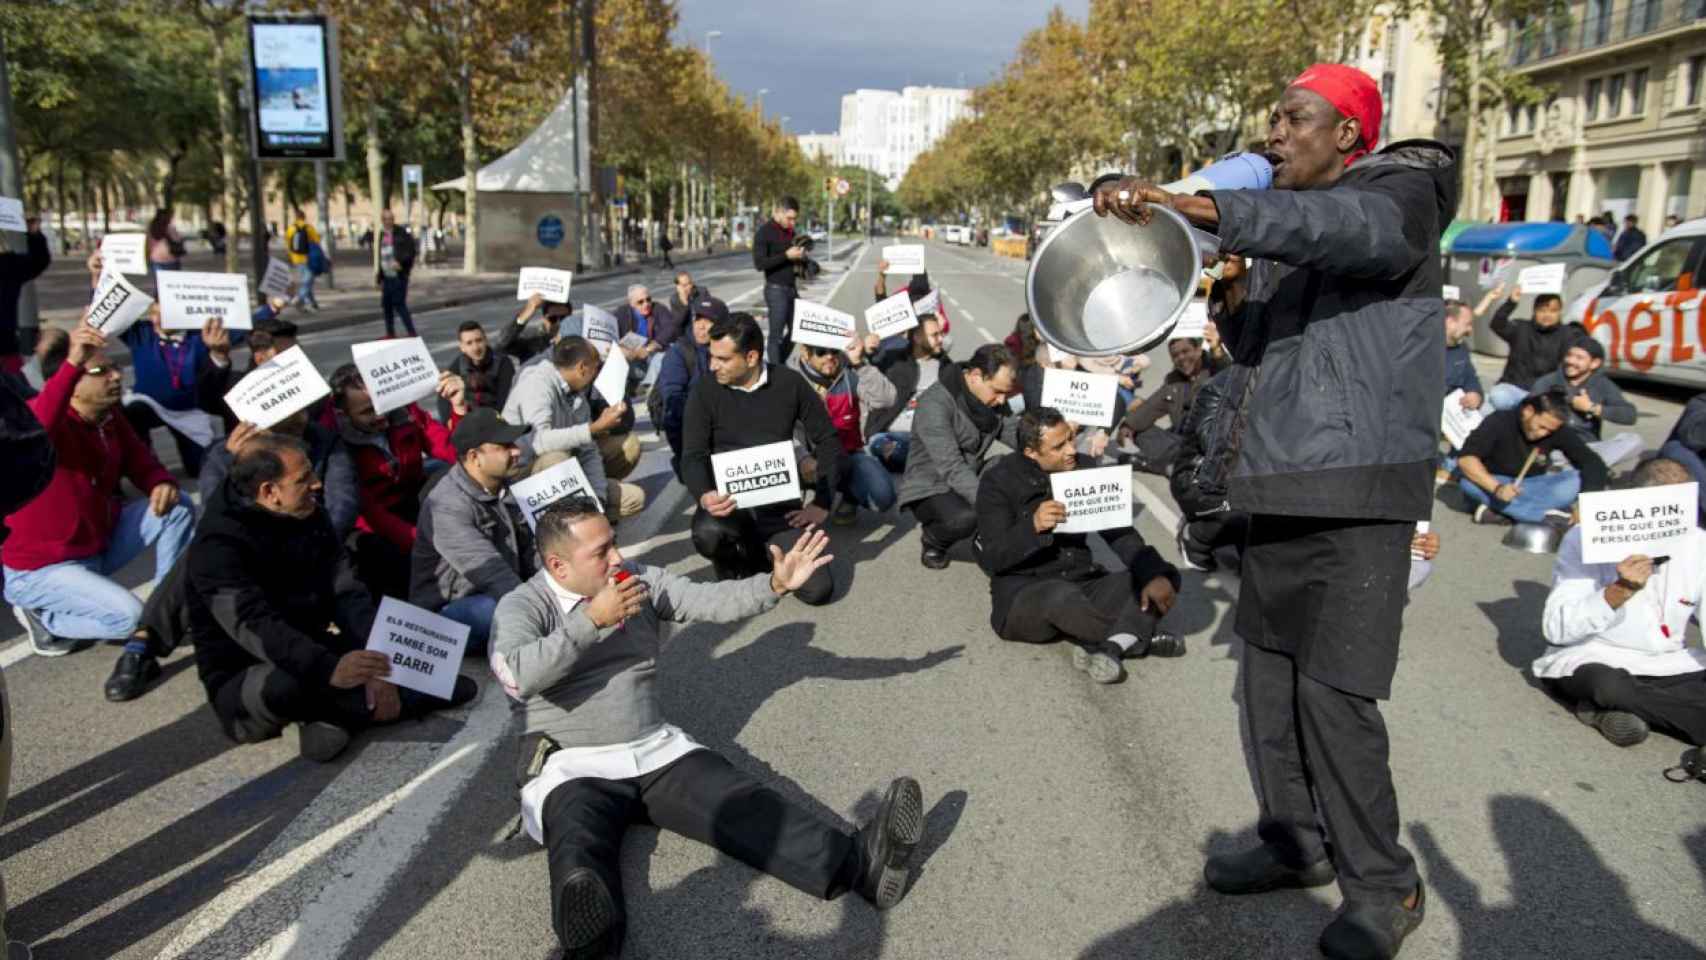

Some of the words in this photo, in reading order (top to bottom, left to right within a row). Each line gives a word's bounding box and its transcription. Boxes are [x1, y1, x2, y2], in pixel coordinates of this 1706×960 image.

[213, 295, 235, 303] SOM
[185, 306, 228, 315] BARRI
[370, 363, 401, 379] GALA
[377, 375, 393, 386] PER
[395, 370, 410, 381] QUE
[411, 364, 426, 376] ENS
[1070, 381, 1089, 391] NO
[260, 386, 302, 412] BARRI
[725, 463, 762, 479] GALA
[764, 456, 787, 470] PIN
[526, 485, 560, 508] GALA
[559, 475, 580, 493] PIN
[728, 472, 788, 493] DIALOGA
[1064, 486, 1097, 499] GALA
[1099, 482, 1124, 494] PIN,
[1067, 504, 1127, 517] ERSEGUEIXES?
[1068, 499, 1085, 508] PER
[1086, 496, 1102, 506] QUE
[1103, 495, 1121, 504] ENS
[1595, 507, 1644, 522] GALA
[1651, 503, 1684, 516] PIN,
[1600, 523, 1626, 533] PER
[1631, 521, 1655, 532] QUE
[1658, 518, 1681, 528] ENS
[1591, 527, 1688, 545] PERSEGUEIXES?
[385, 615, 403, 628] ELS
[404, 620, 459, 646] RESTAURADORS
[388, 631, 426, 652] TAMBÉ
[426, 645, 449, 661] SOM
[392, 652, 435, 676] BARRI
